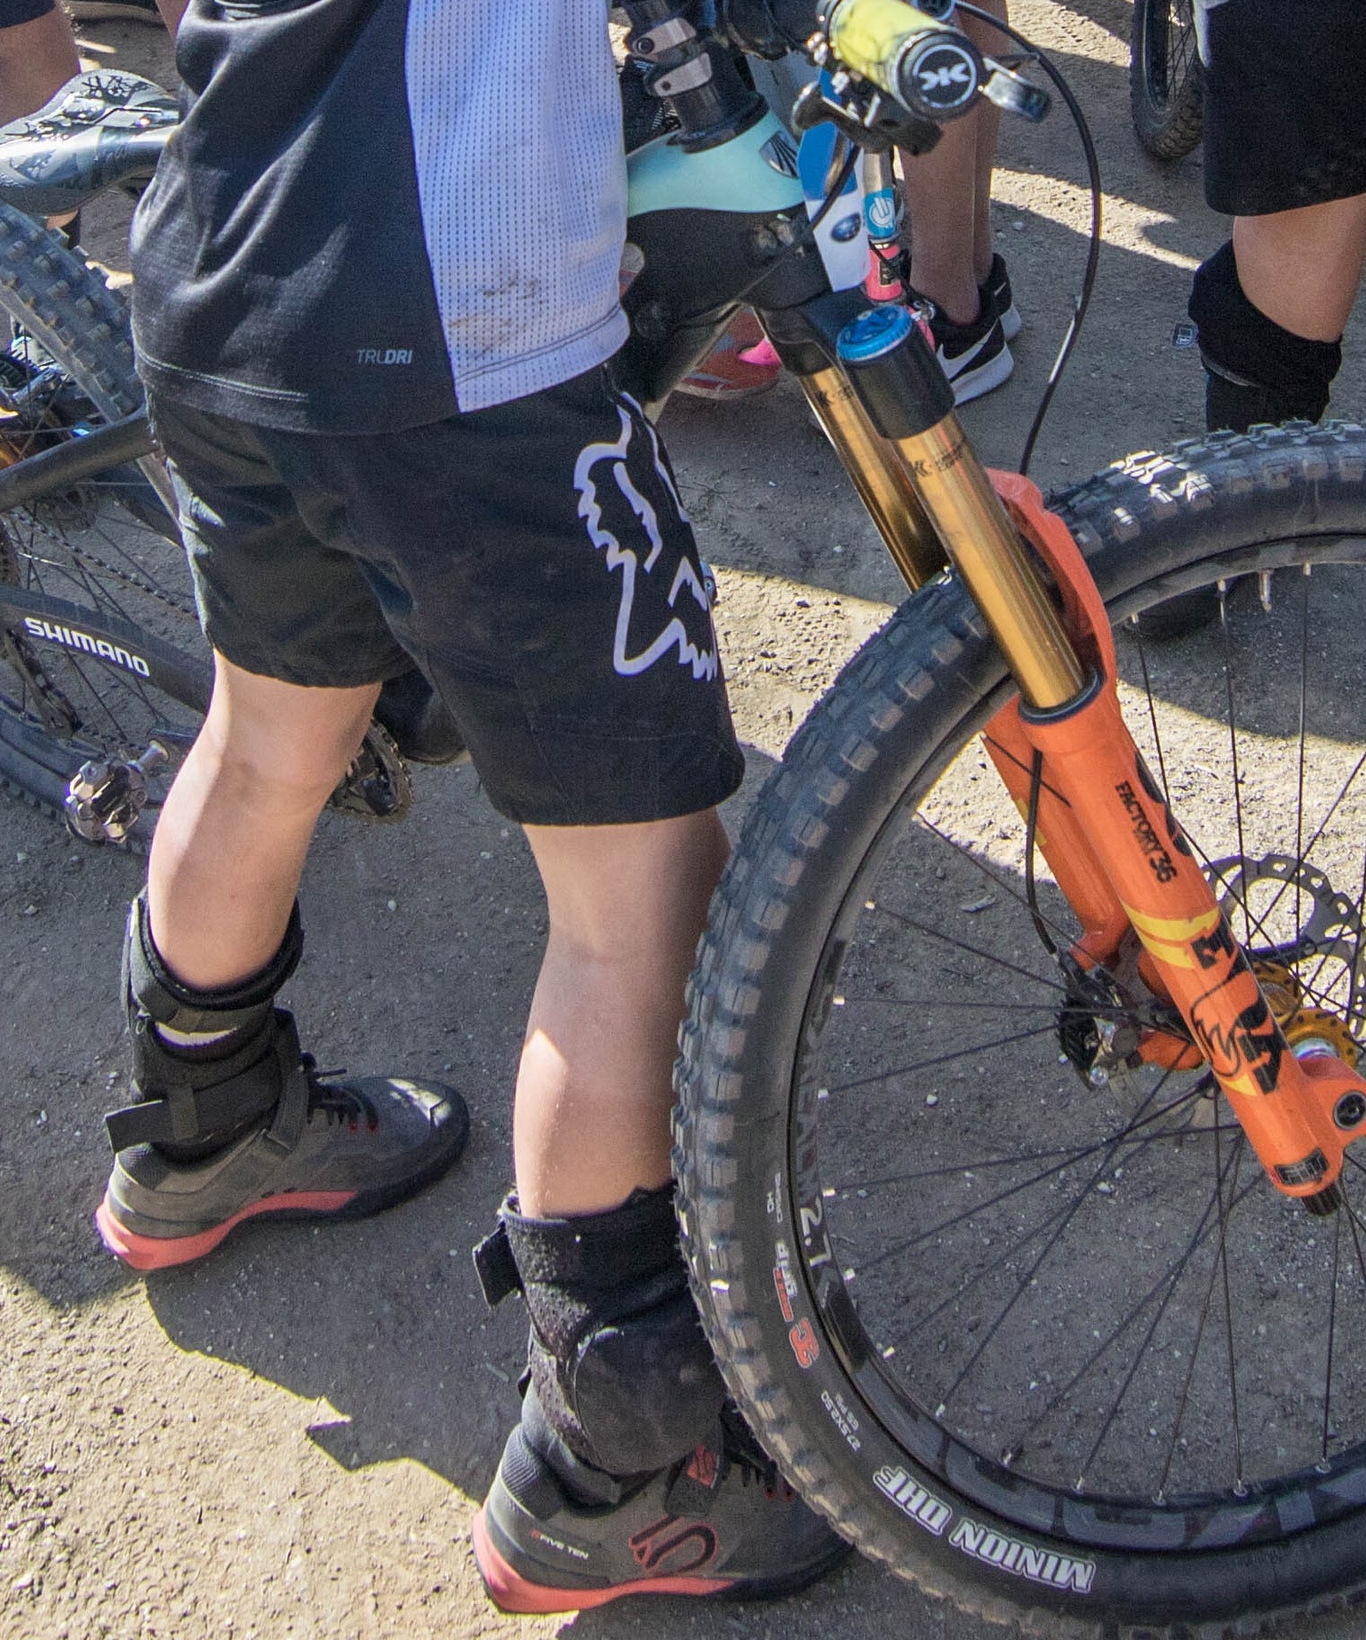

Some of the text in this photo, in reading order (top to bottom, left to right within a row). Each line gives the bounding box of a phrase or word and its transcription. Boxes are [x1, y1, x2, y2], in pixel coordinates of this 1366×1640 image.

[24, 616, 152, 678] SHIMANO
[1114, 779, 1178, 884] FACTORY 36
[800, 1195, 832, 1268] 2.7
[873, 1465, 954, 1536] DHF
[539, 1533, 589, 1560] FIVE TEN
[948, 1516, 1097, 1594] MINION
